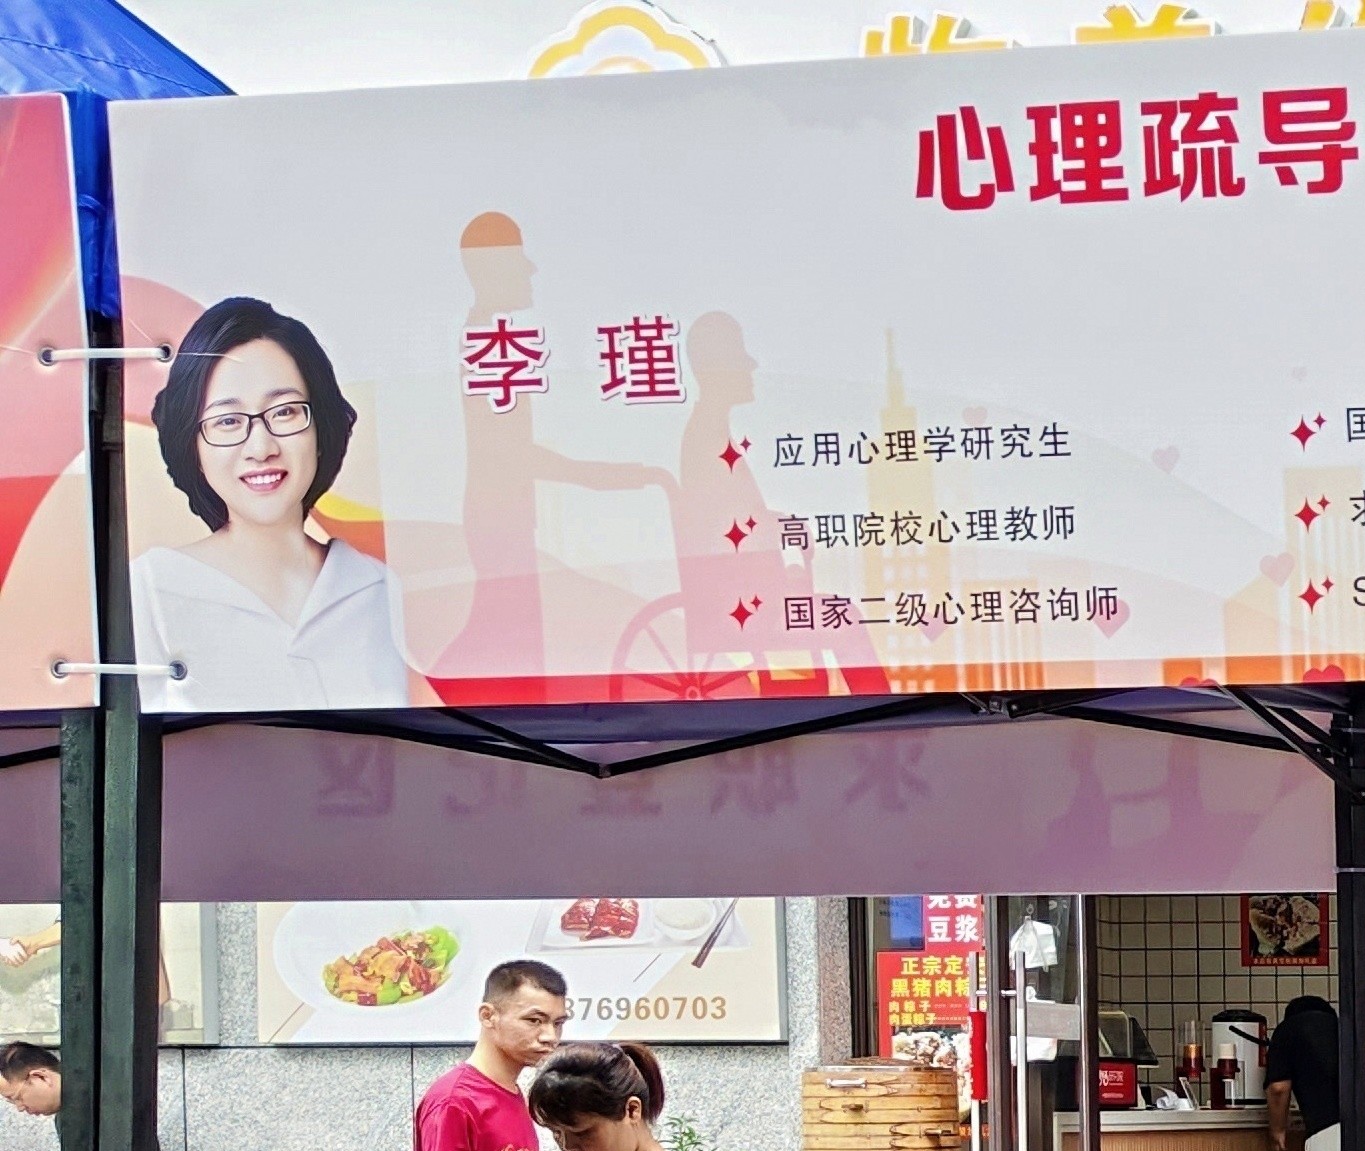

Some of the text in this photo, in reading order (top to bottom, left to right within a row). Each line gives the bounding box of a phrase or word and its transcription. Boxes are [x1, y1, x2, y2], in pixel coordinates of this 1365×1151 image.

[774, 423, 1072, 468] 应用心理学研究生
[779, 505, 1074, 551] 高职院校心理教师
[784, 587, 1118, 631] 国家二级心理咨询师
[927, 914, 979, 942] 豆浆
